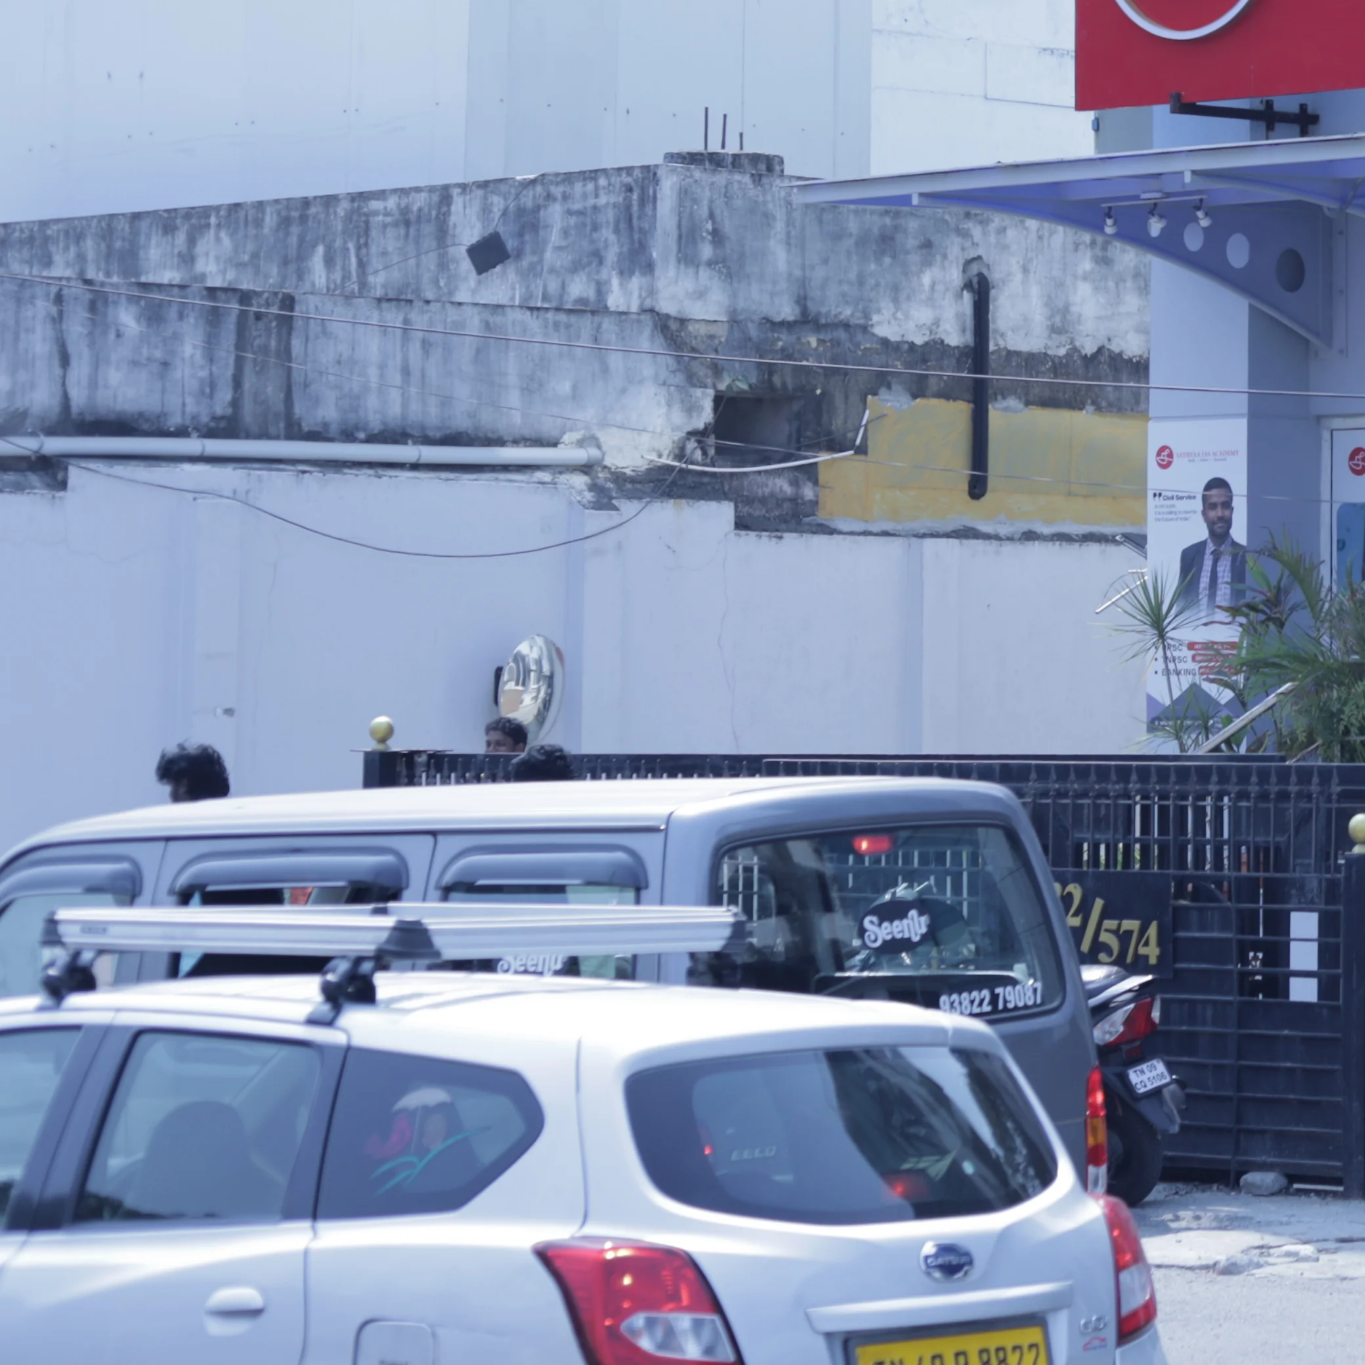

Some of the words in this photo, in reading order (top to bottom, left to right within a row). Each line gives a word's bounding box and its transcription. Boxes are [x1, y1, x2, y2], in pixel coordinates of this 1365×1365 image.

[939, 989, 993, 1016] 93822
[995, 983, 1043, 1010] 79087
[1132, 1067, 1146, 1078] TN
